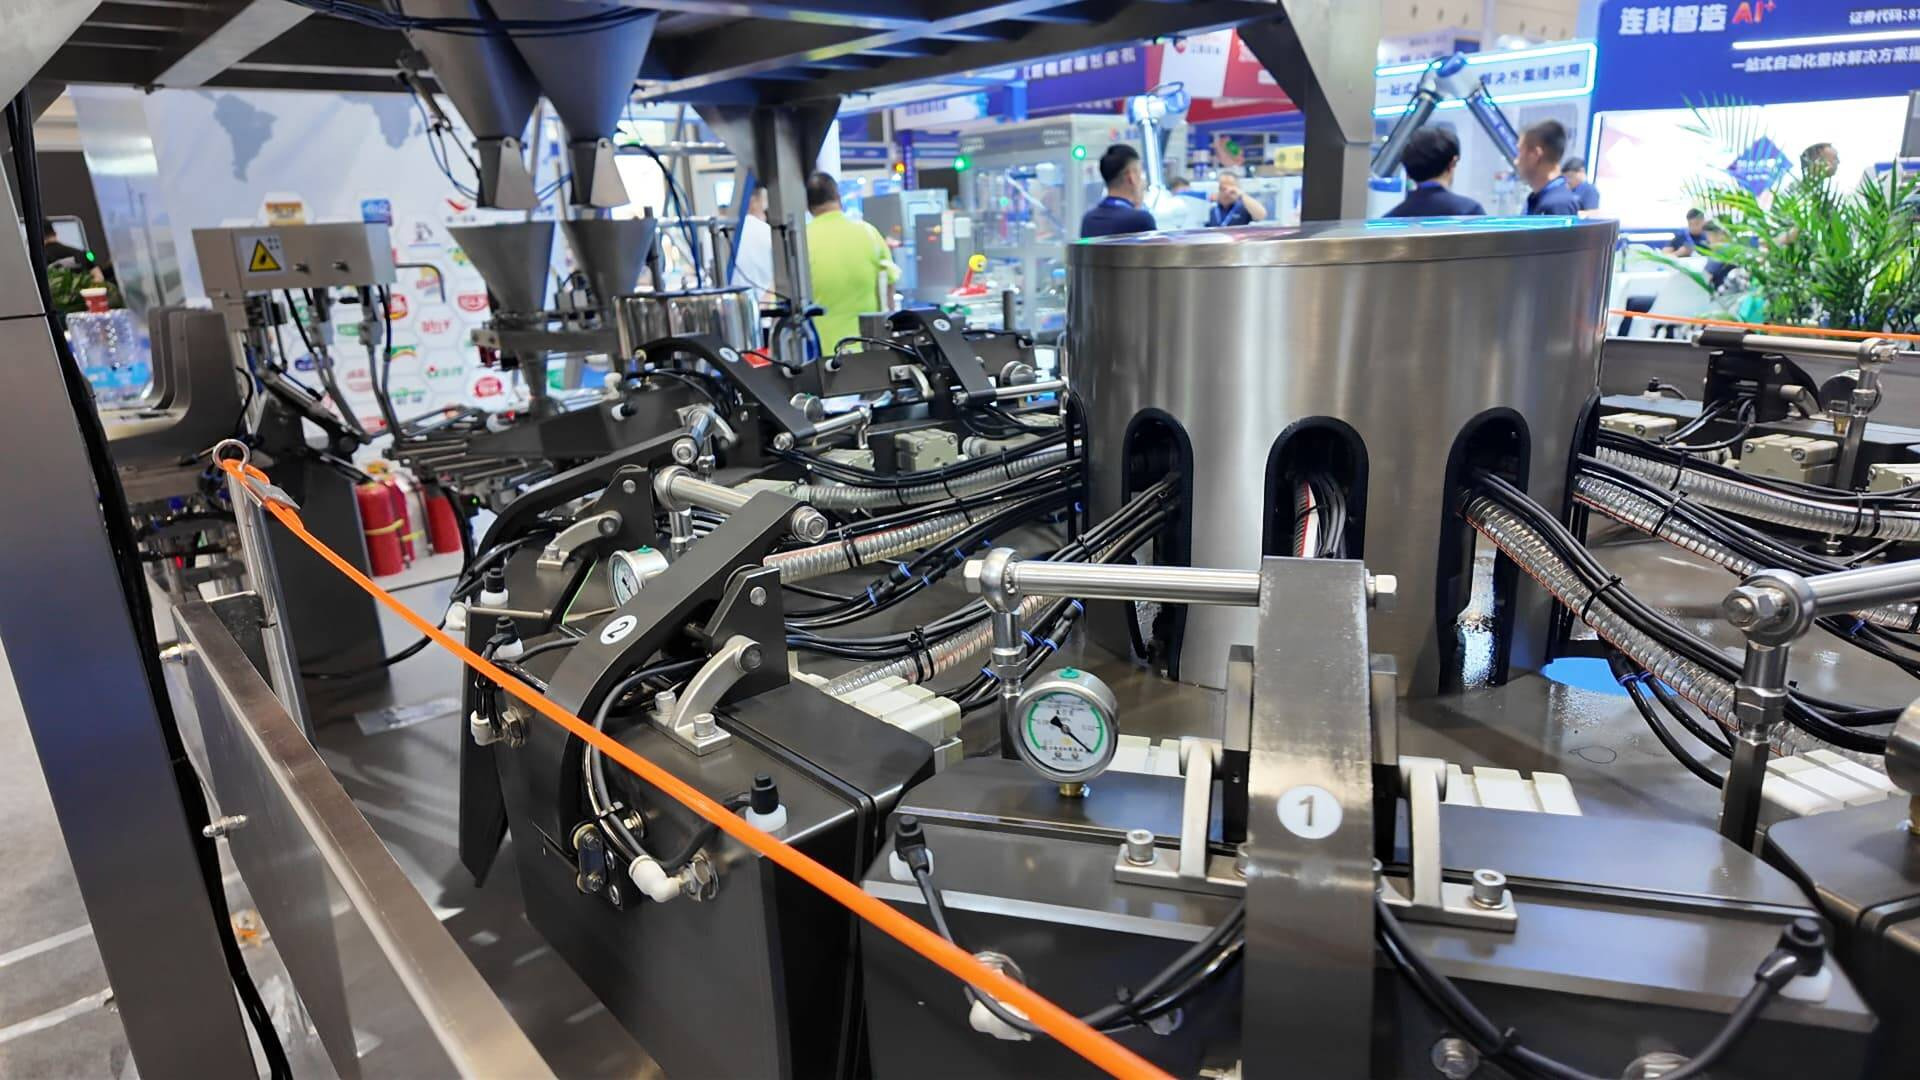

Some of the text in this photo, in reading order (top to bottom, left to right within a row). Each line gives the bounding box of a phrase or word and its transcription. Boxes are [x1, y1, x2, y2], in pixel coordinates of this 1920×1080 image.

[1849, 8, 1920, 25] 证券代码:8
[1299, 795, 1315, 827] 1
